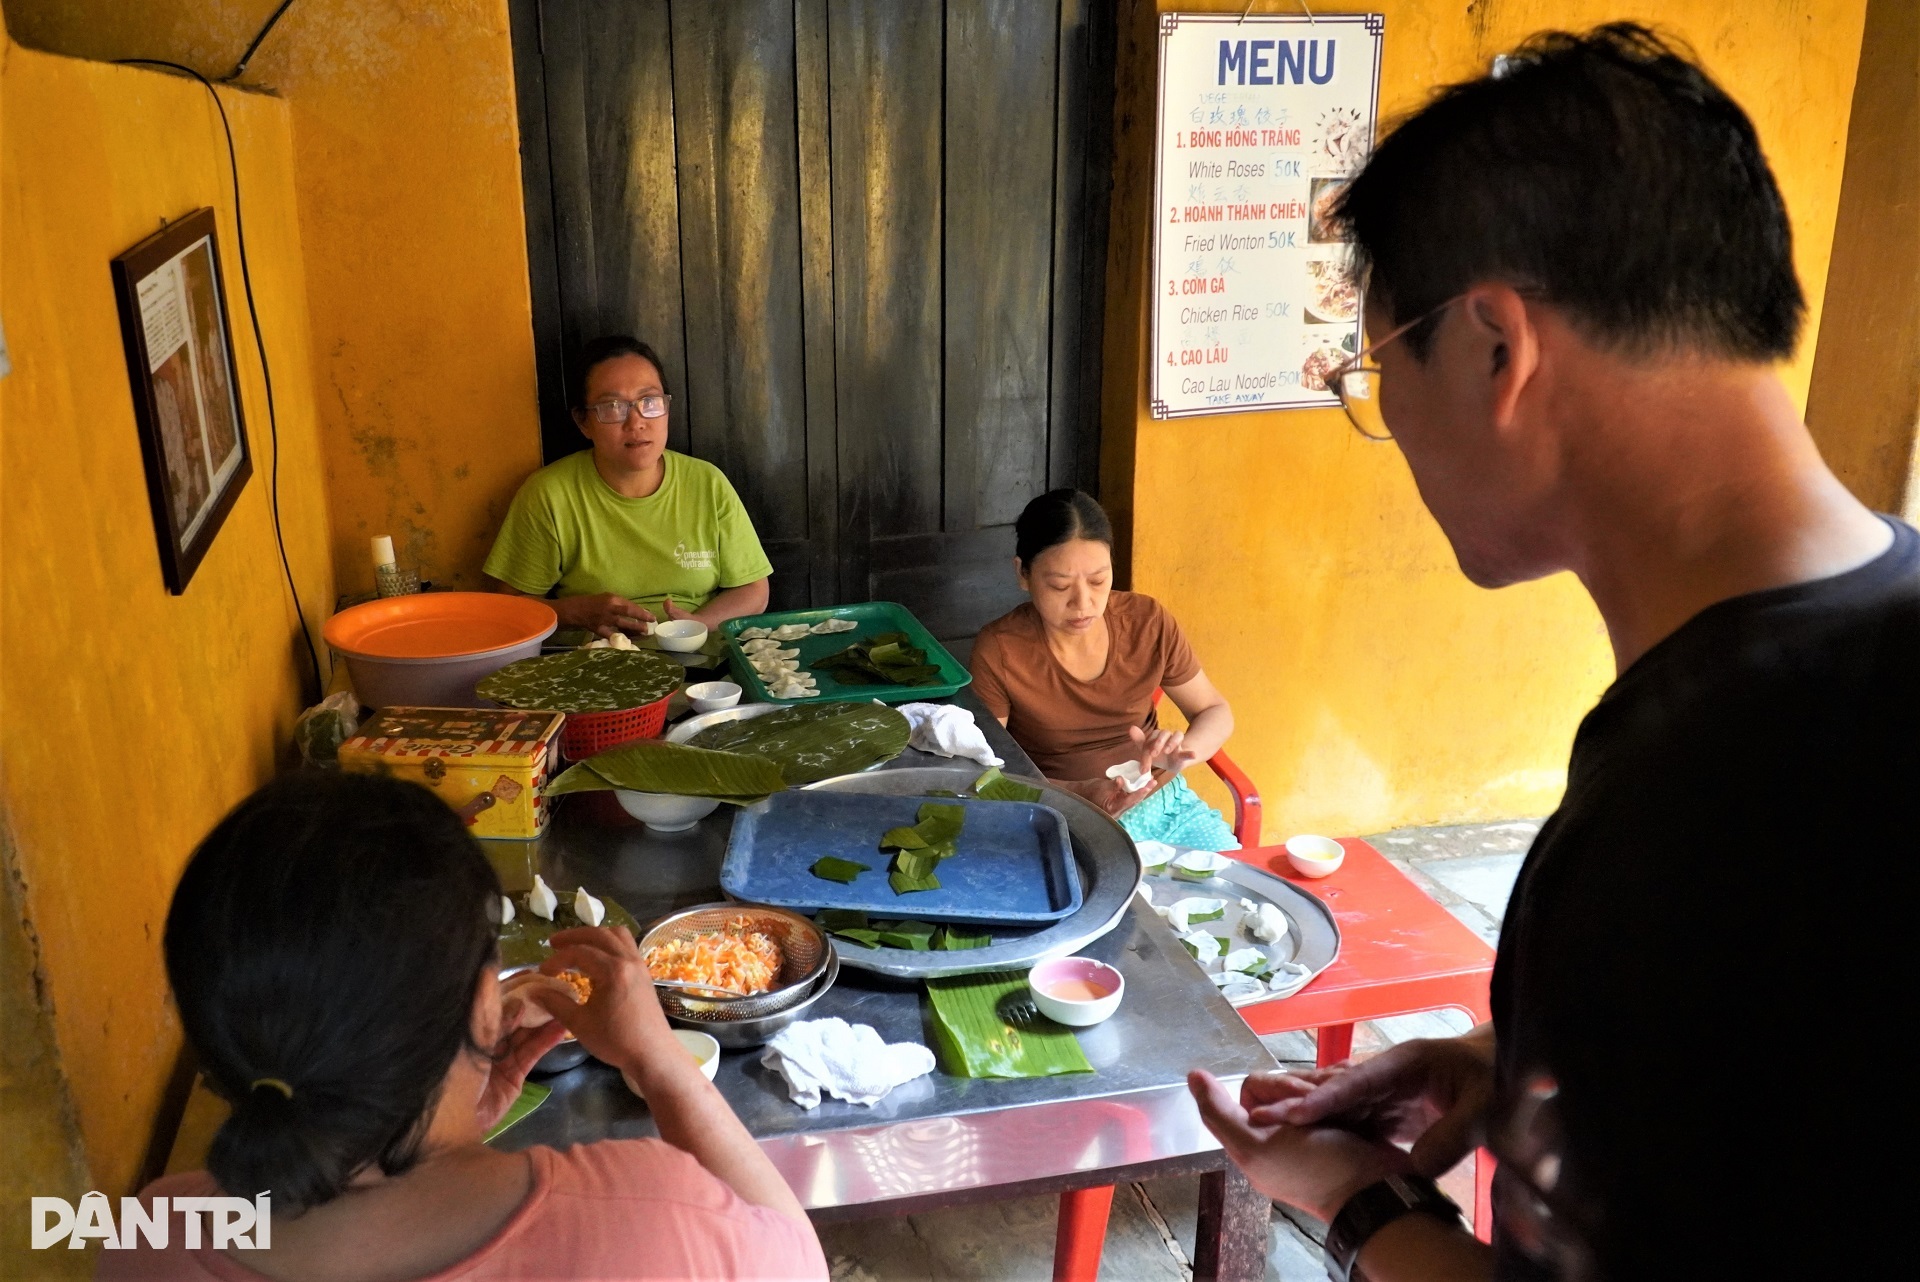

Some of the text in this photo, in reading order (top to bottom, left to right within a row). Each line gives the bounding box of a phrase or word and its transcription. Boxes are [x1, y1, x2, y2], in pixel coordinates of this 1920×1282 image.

[1218, 40, 1336, 85] MENU
[1176, 122, 1301, 148] 1. BÔNG HỒNG TRẮNG
[1189, 160, 1301, 178] White Roses 50K
[1170, 199, 1306, 223] 2. HOÀNH THÁNH CHIÊN
[1184, 231, 1296, 252] Fried Wonton 50K
[1168, 272, 1225, 296] 3. CƠM GÀ
[1181, 305, 1227, 324] Chicken
[1232, 304, 1259, 321] Rice
[1167, 351, 1177, 367] 4.
[1181, 349, 1203, 365] CAO
[1181, 377, 1205, 394] Cao
[1209, 376, 1231, 392] Lau
[1235, 372, 1277, 390] Noodle
[1206, 392, 1265, 406] TAKE AWAY
